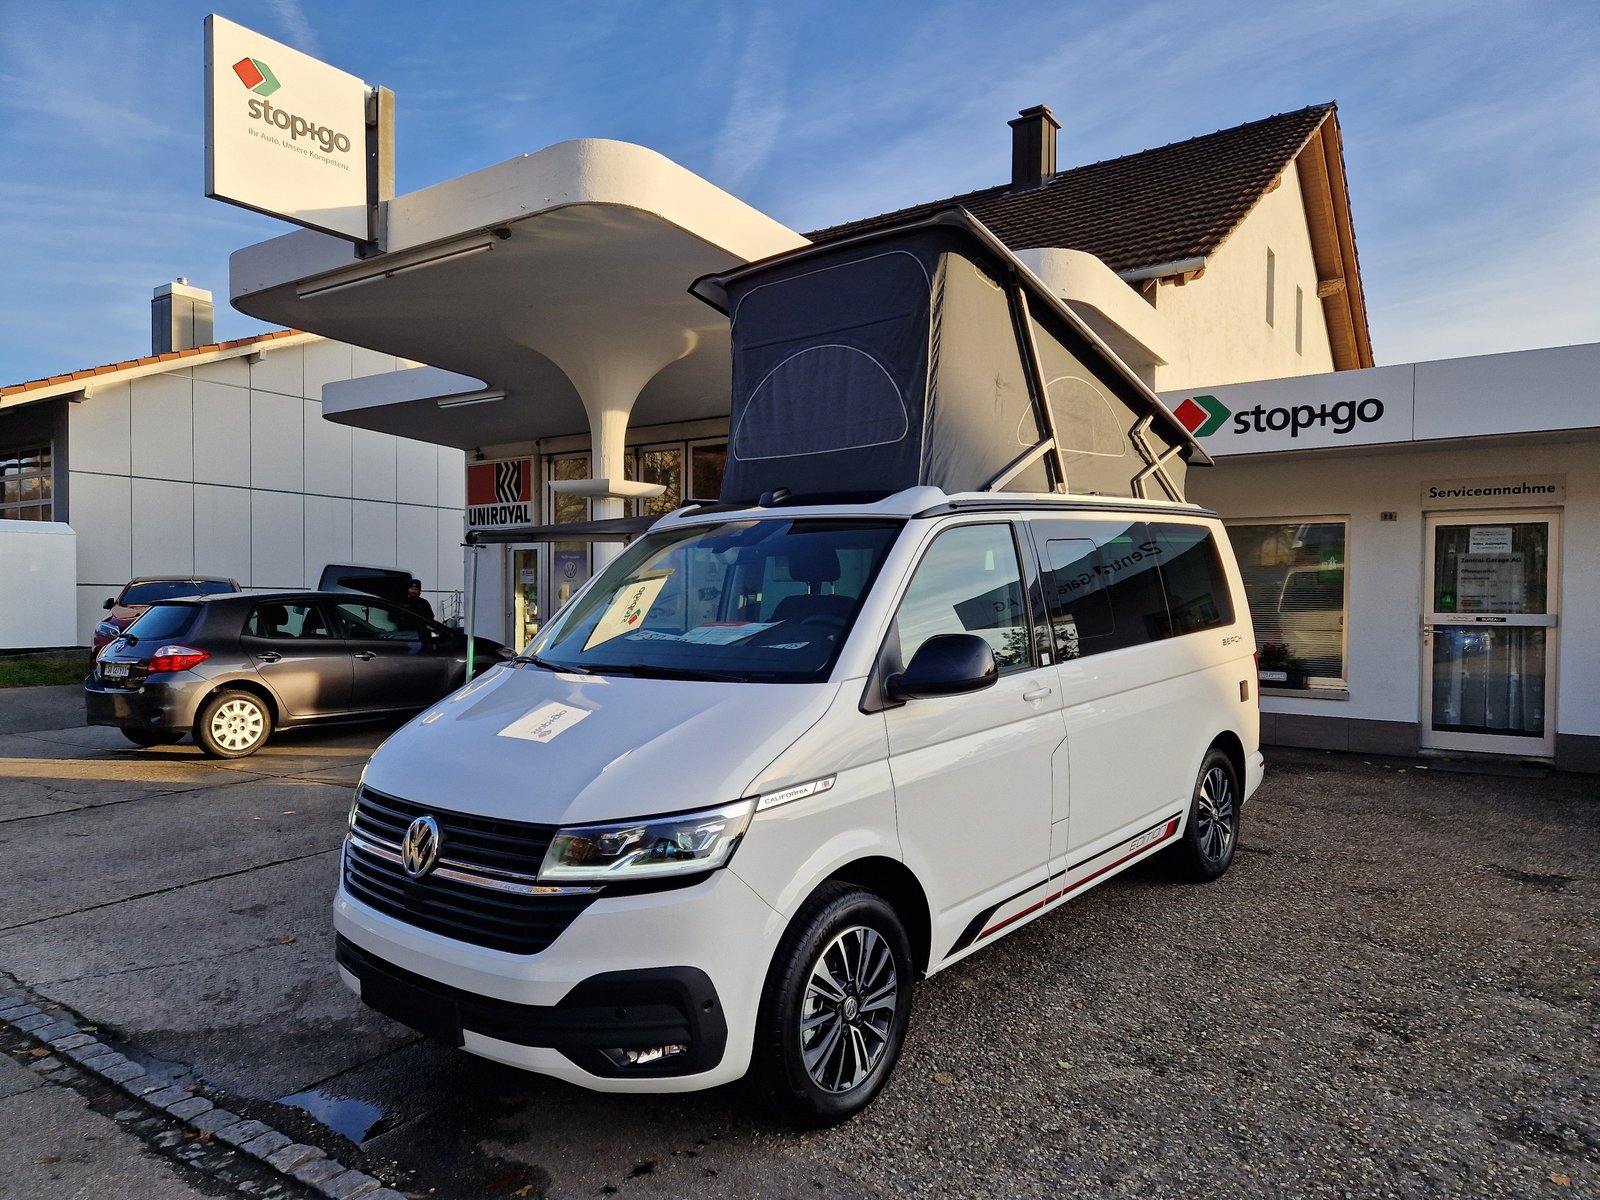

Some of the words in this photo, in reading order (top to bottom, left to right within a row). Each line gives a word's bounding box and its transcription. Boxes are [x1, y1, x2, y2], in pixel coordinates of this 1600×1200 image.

[248, 98, 351, 153] stop+go
[248, 127, 260, 139] Ihr
[261, 131, 281, 147] Auto.
[282, 140, 308, 156] Unsere
[309, 150, 351, 172] Kompetenz.
[1233, 398, 1385, 438] stop+go
[1429, 482, 1556, 498] Serviceannahme
[468, 504, 531, 526] UNIROYAL
[1222, 635, 1243, 646] BEACH
[764, 788, 809, 804] CALIFORNIA
